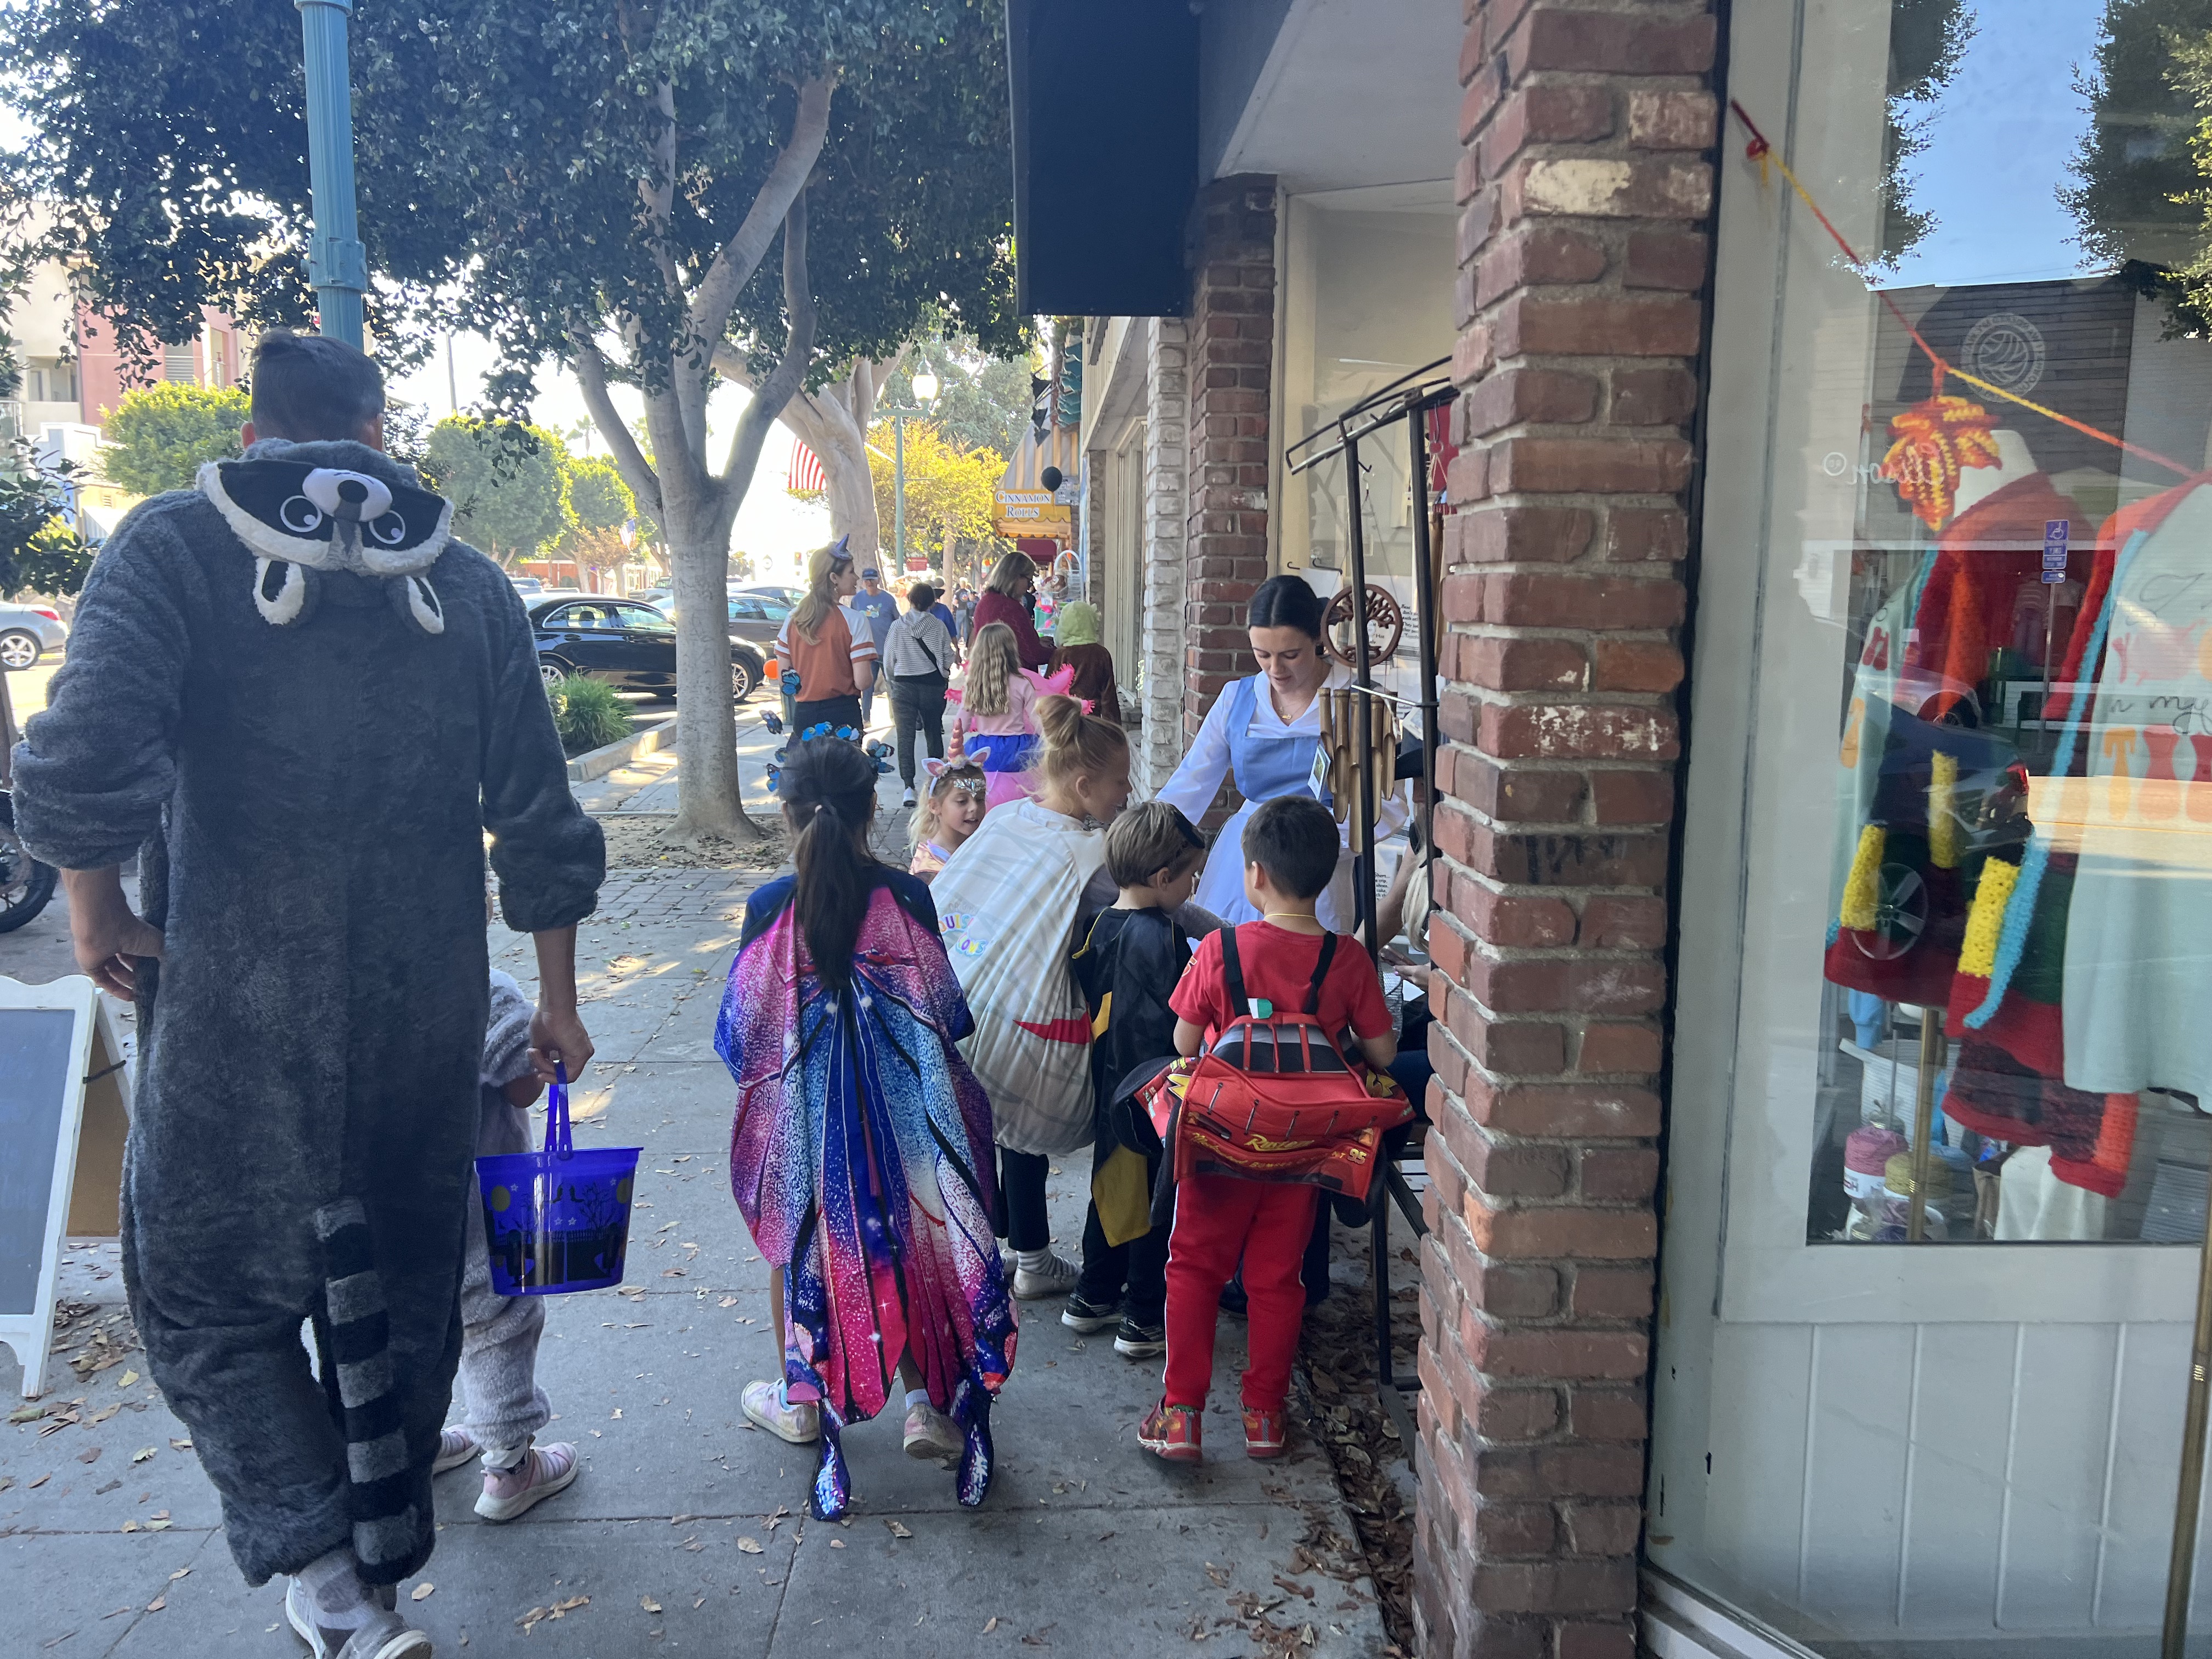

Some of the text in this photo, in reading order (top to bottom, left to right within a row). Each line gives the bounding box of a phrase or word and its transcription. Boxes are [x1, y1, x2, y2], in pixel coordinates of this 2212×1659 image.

[996, 491, 1051, 503] CINNAMON
[1006, 506, 1039, 517] ROLLS
[1347, 1148, 1368, 1165] 95
